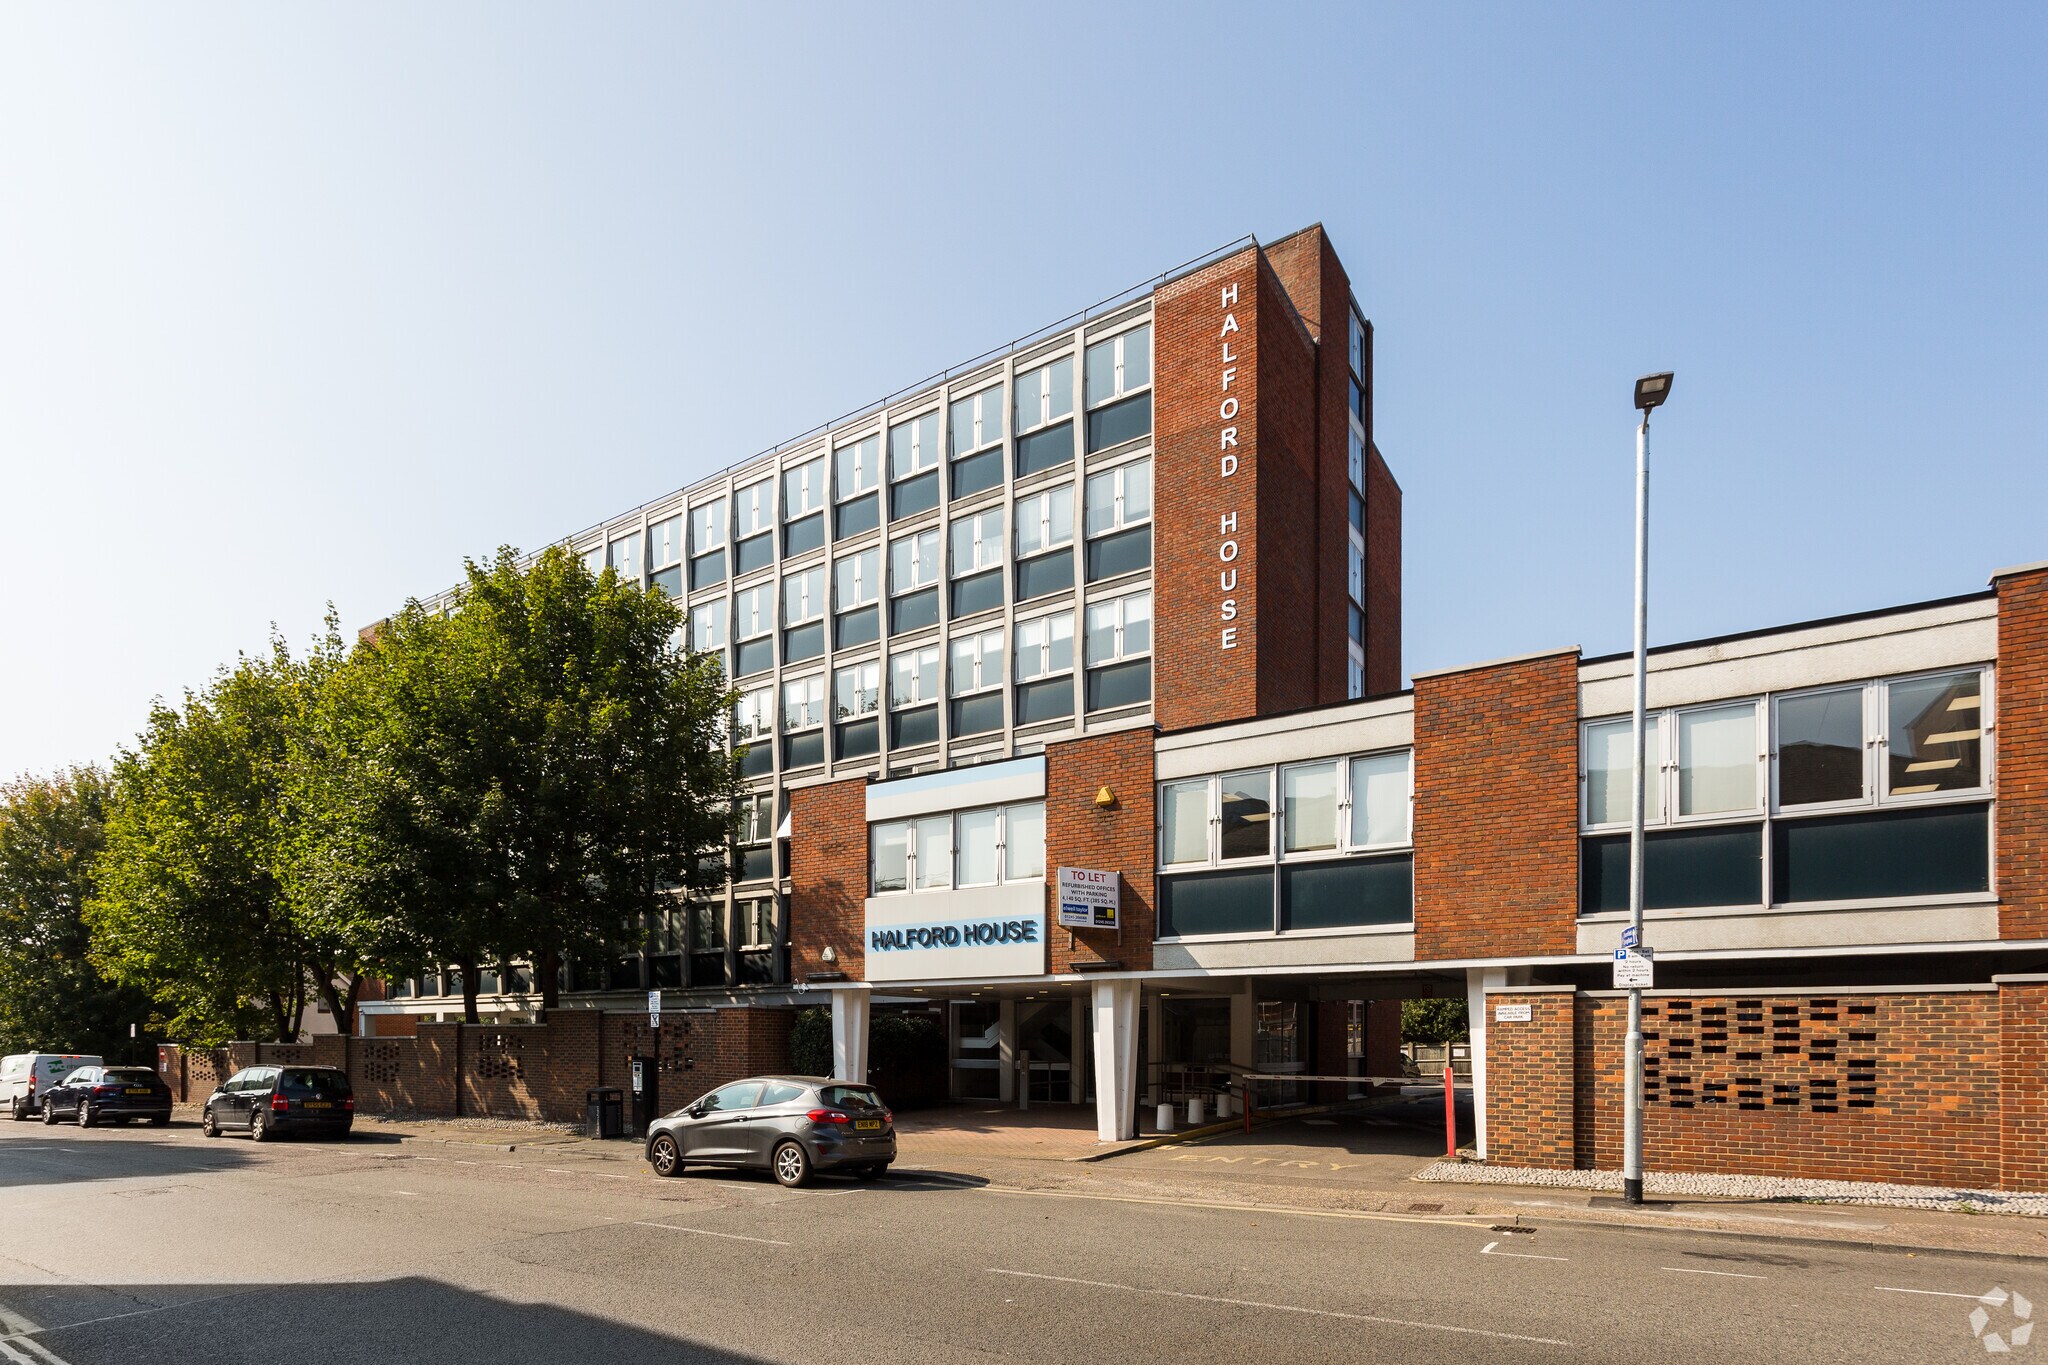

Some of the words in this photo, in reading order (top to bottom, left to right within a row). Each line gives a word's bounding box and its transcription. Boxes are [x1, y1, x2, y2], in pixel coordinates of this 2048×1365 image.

[1219, 282, 1239, 478] HALFORD
[1219, 511, 1239, 650] HOUSE
[1071, 870, 1086, 880] TO
[1088, 872, 1106, 882] LET
[1062, 882, 1095, 890] REFURBISHED
[871, 925, 959, 949] HALFORD
[963, 919, 1036, 943] HOUSE
[1617, 950, 1626, 959] P
[1168, 1154, 1361, 1171] ENTRY
